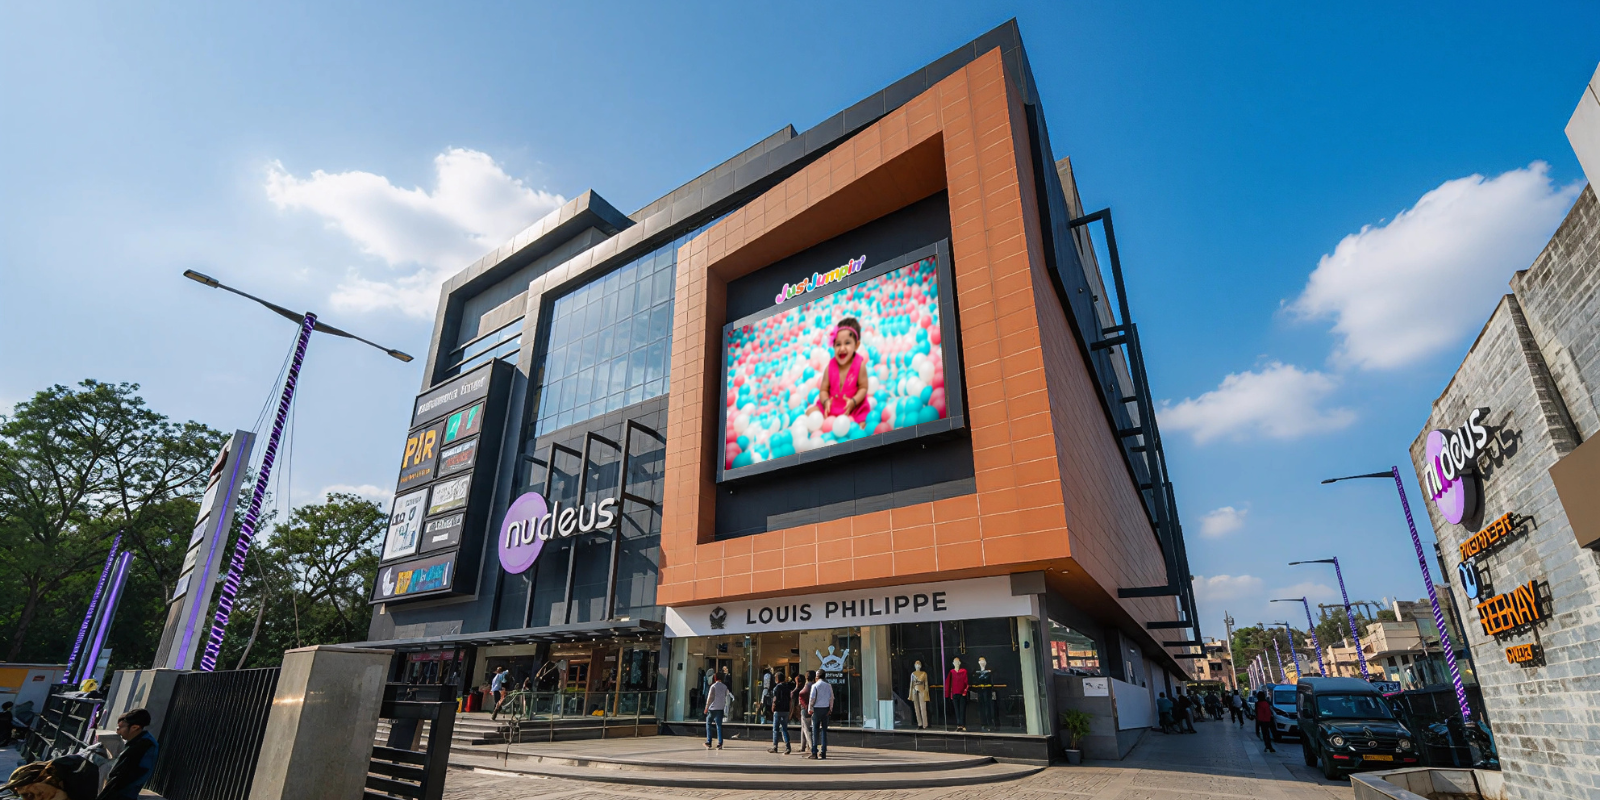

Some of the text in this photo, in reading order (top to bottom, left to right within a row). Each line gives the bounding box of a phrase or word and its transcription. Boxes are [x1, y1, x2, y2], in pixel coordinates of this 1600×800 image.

[775, 255, 866, 304] Jus' Jumpin'
[505, 497, 616, 550] nucleus
[746, 591, 947, 625] LOUIS PHILIPPE
